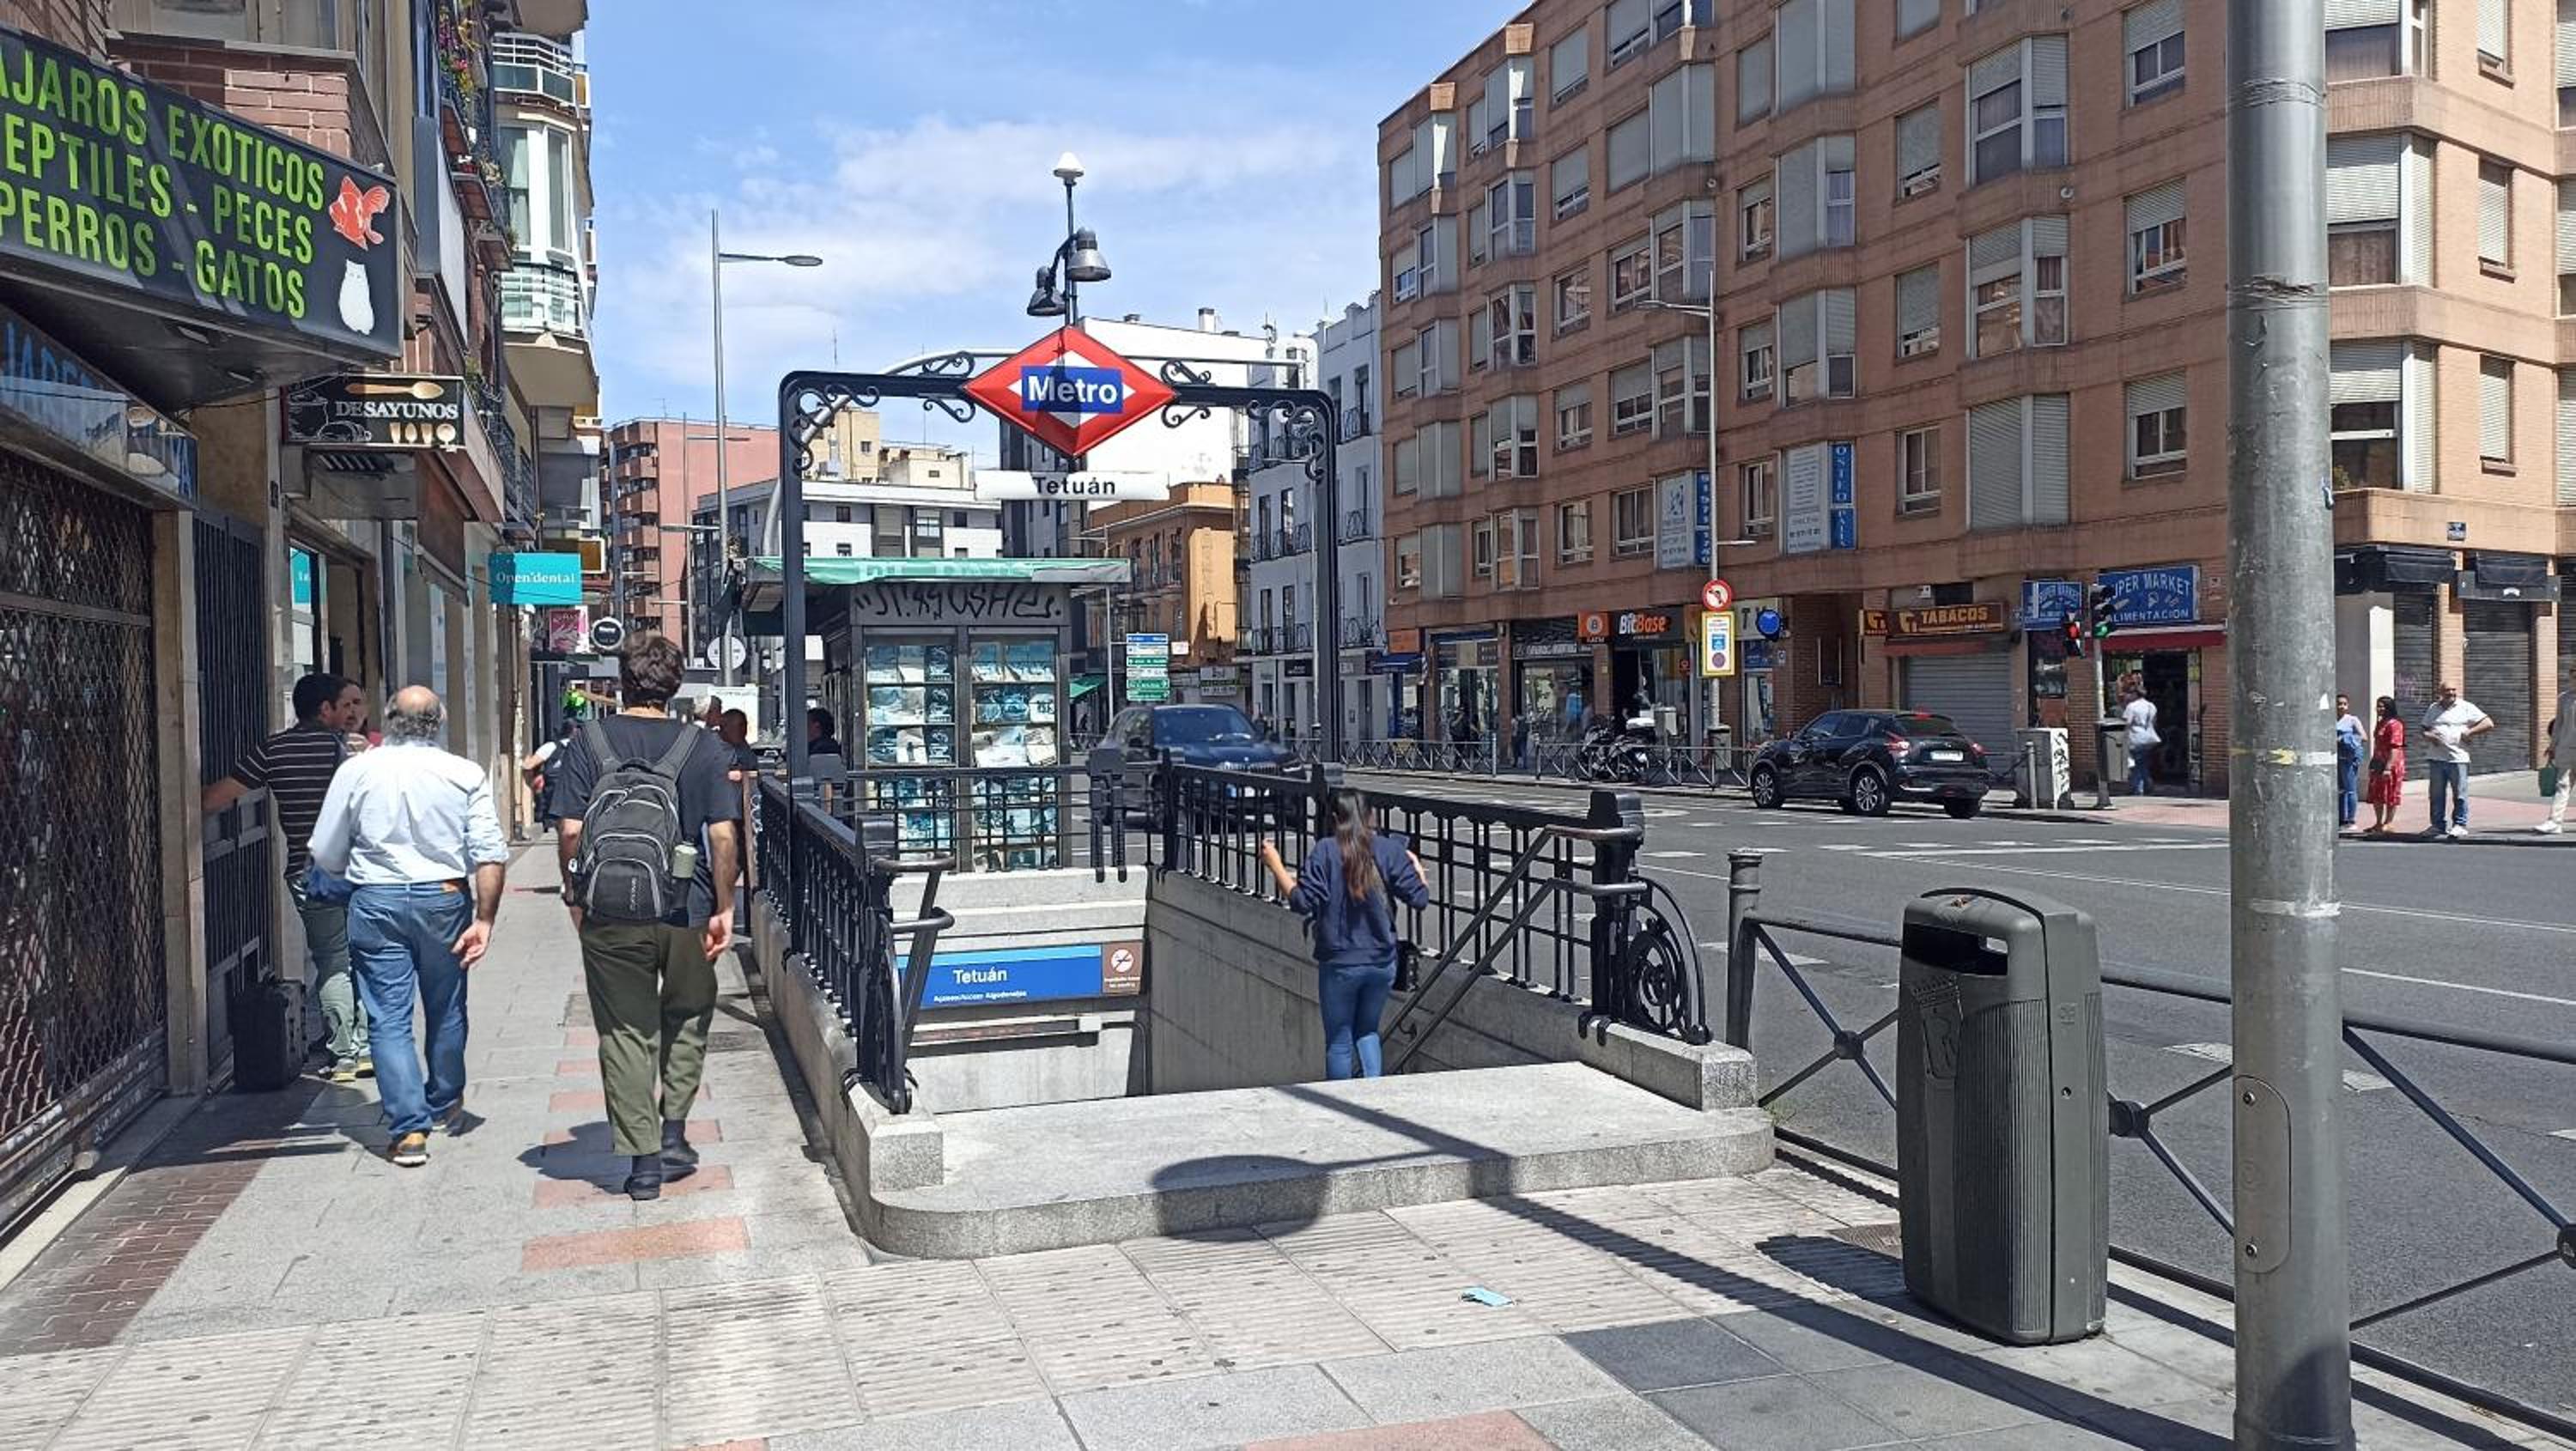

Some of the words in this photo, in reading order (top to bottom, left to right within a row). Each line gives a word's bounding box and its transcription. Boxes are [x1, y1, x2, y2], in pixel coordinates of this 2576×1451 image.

[167, 104, 324, 210] EXOTICOS
[214, 183, 313, 264] PECES
[0, 180, 157, 276] PERROS
[196, 240, 306, 319] GATOS
[1027, 374, 1118, 405] Metro
[335, 400, 459, 419] DESAYUNOS
[1033, 476, 1116, 495] Tetuán
[2142, 572, 2191, 597] MARKET
[1619, 612, 1667, 634] BitBase
[1920, 606, 1989, 625] TABACOS
[952, 966, 1008, 986] Tetuán
